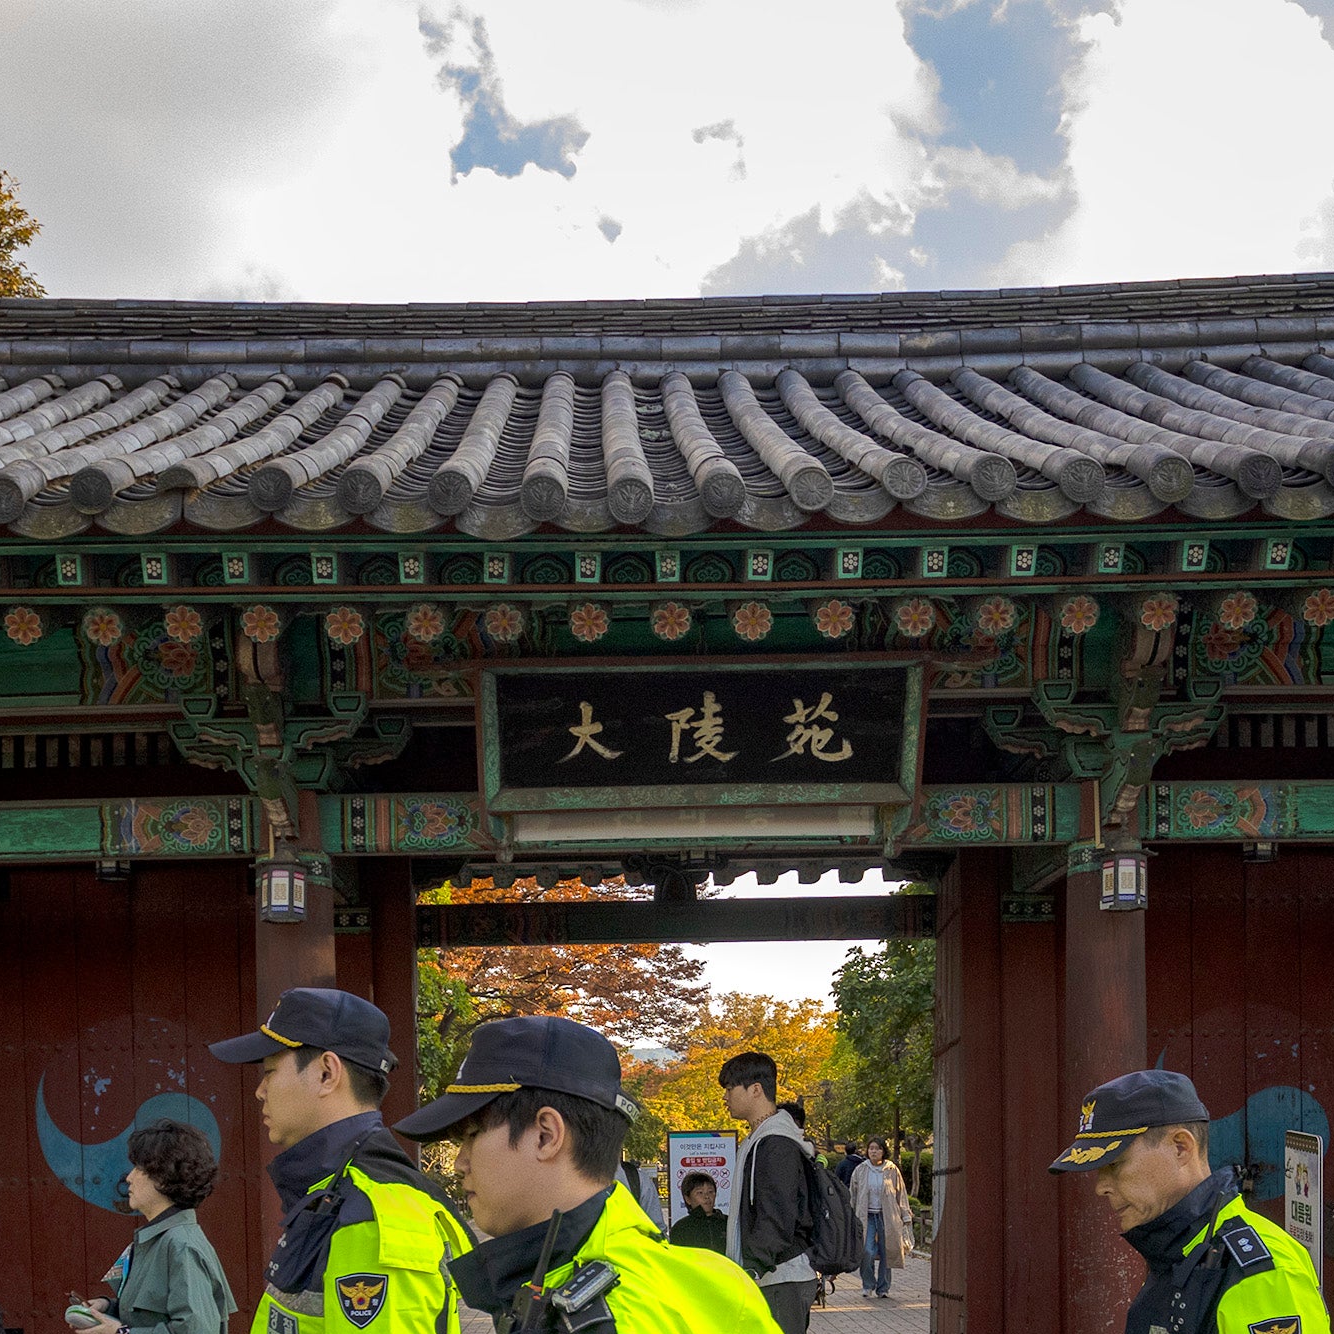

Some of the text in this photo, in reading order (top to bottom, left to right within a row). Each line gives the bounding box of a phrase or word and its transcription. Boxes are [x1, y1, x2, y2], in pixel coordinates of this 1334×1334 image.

[554, 690, 855, 764] 大陵苑
[1291, 1200, 1312, 1227] 대릉원
[350, 1309, 372, 1317] POLICE
